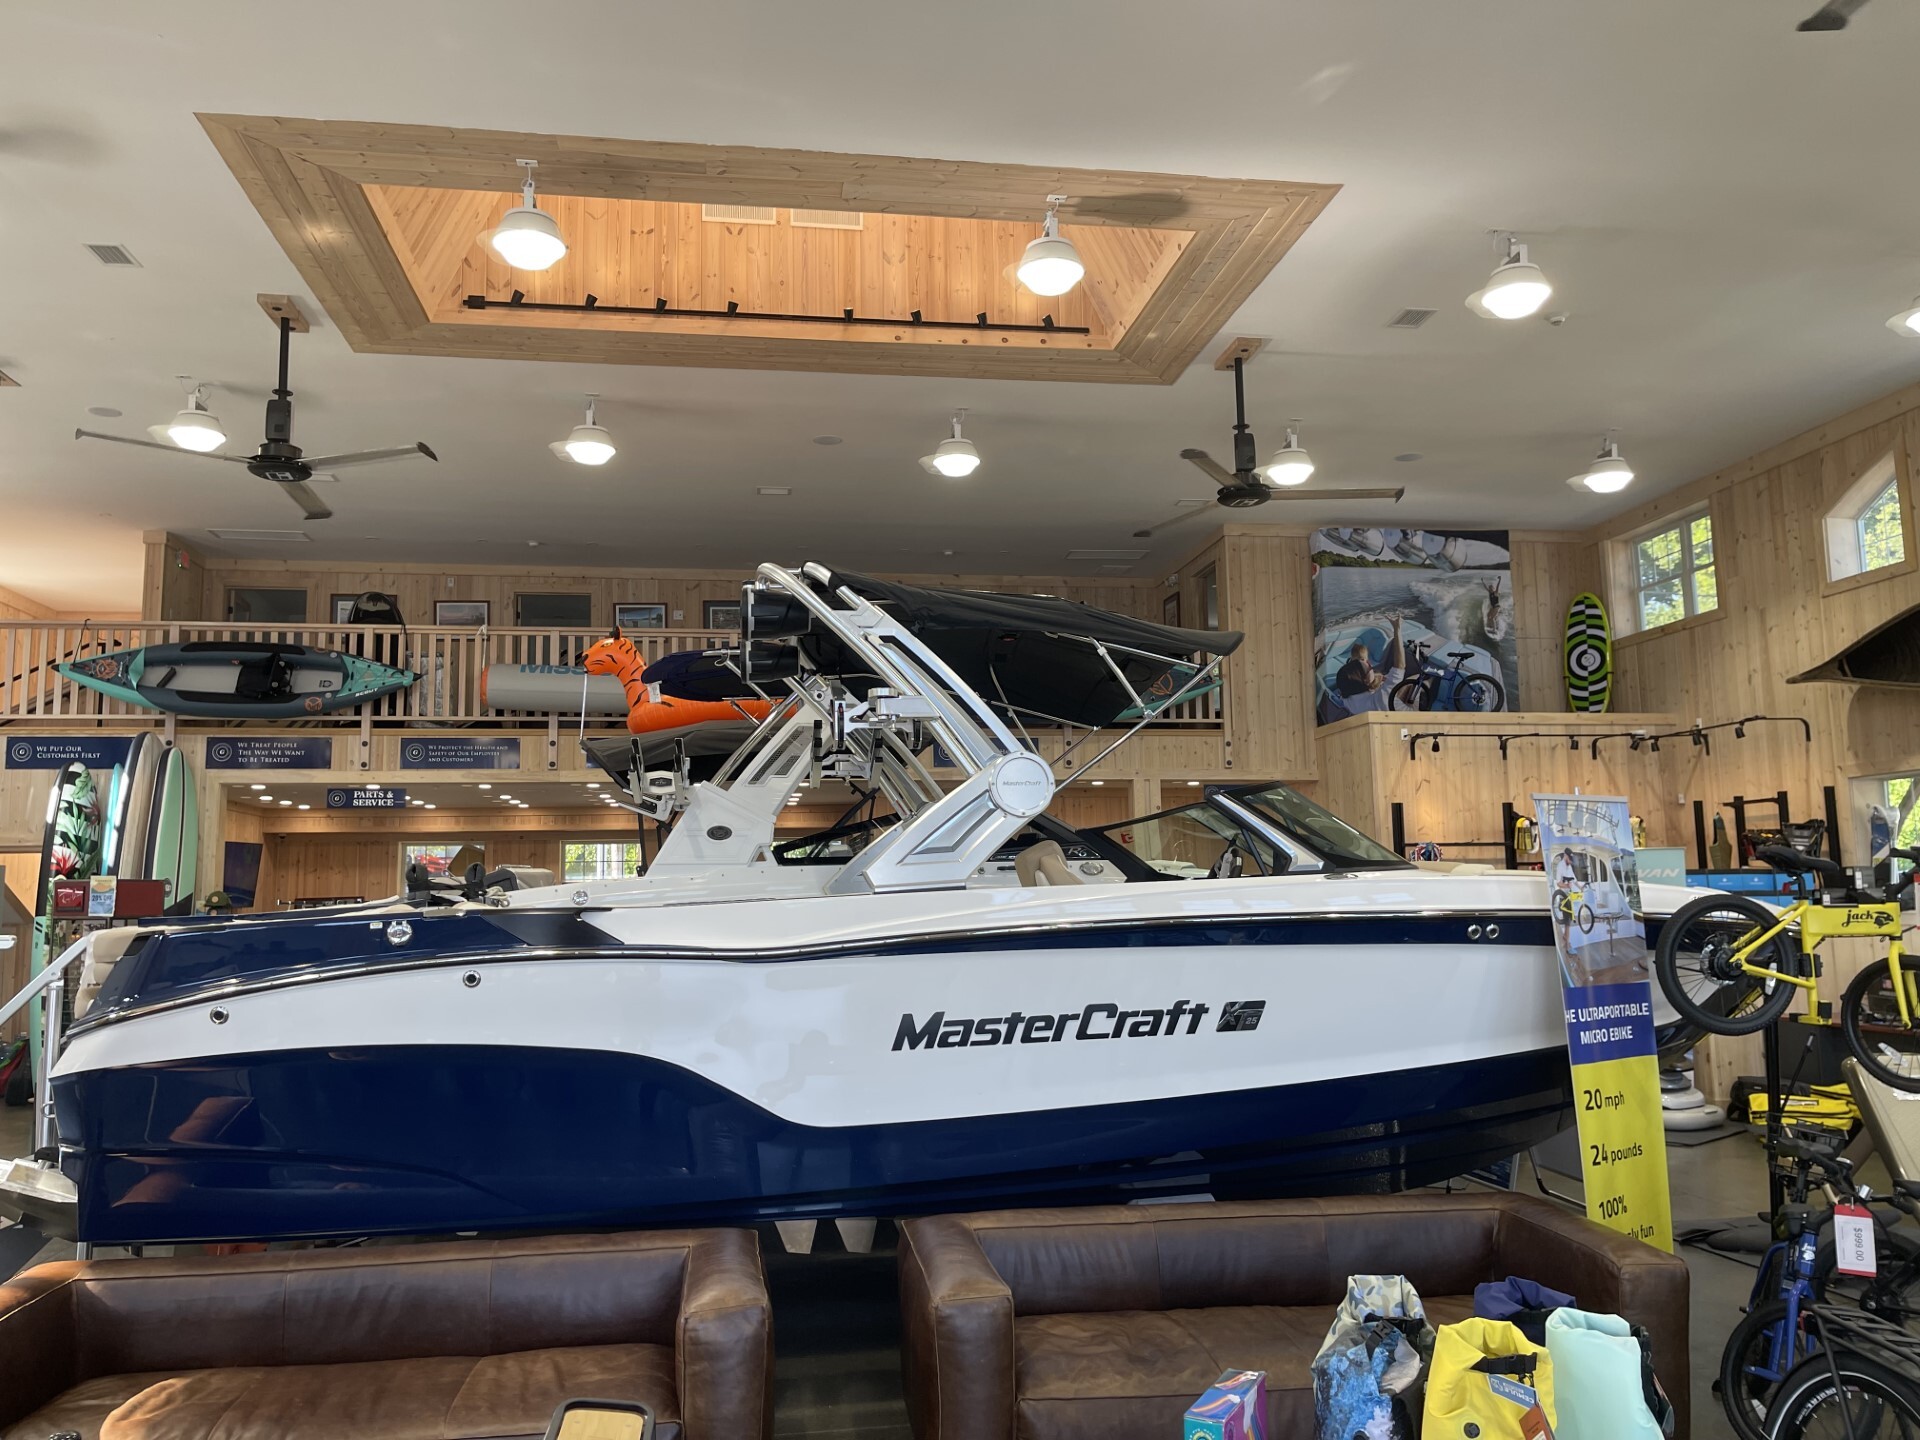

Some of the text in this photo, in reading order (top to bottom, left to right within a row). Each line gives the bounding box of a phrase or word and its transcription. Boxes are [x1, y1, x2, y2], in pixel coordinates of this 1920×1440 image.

[352, 798, 394, 807] SERVICE
[353, 790, 394, 799] PARTS &
[1841, 909, 1874, 927] jack
[1565, 1003, 1650, 1023] HE ULTRAPORTABLE
[891, 1000, 1210, 1051] MasterCraft
[1580, 1026, 1633, 1045] MICRO EBIKE
[1583, 1088, 1625, 1111] 20 mph
[1590, 1142, 1643, 1166] 24 pounds
[1598, 1194, 1627, 1220] 100%
[1640, 1224, 1654, 1239] fun
